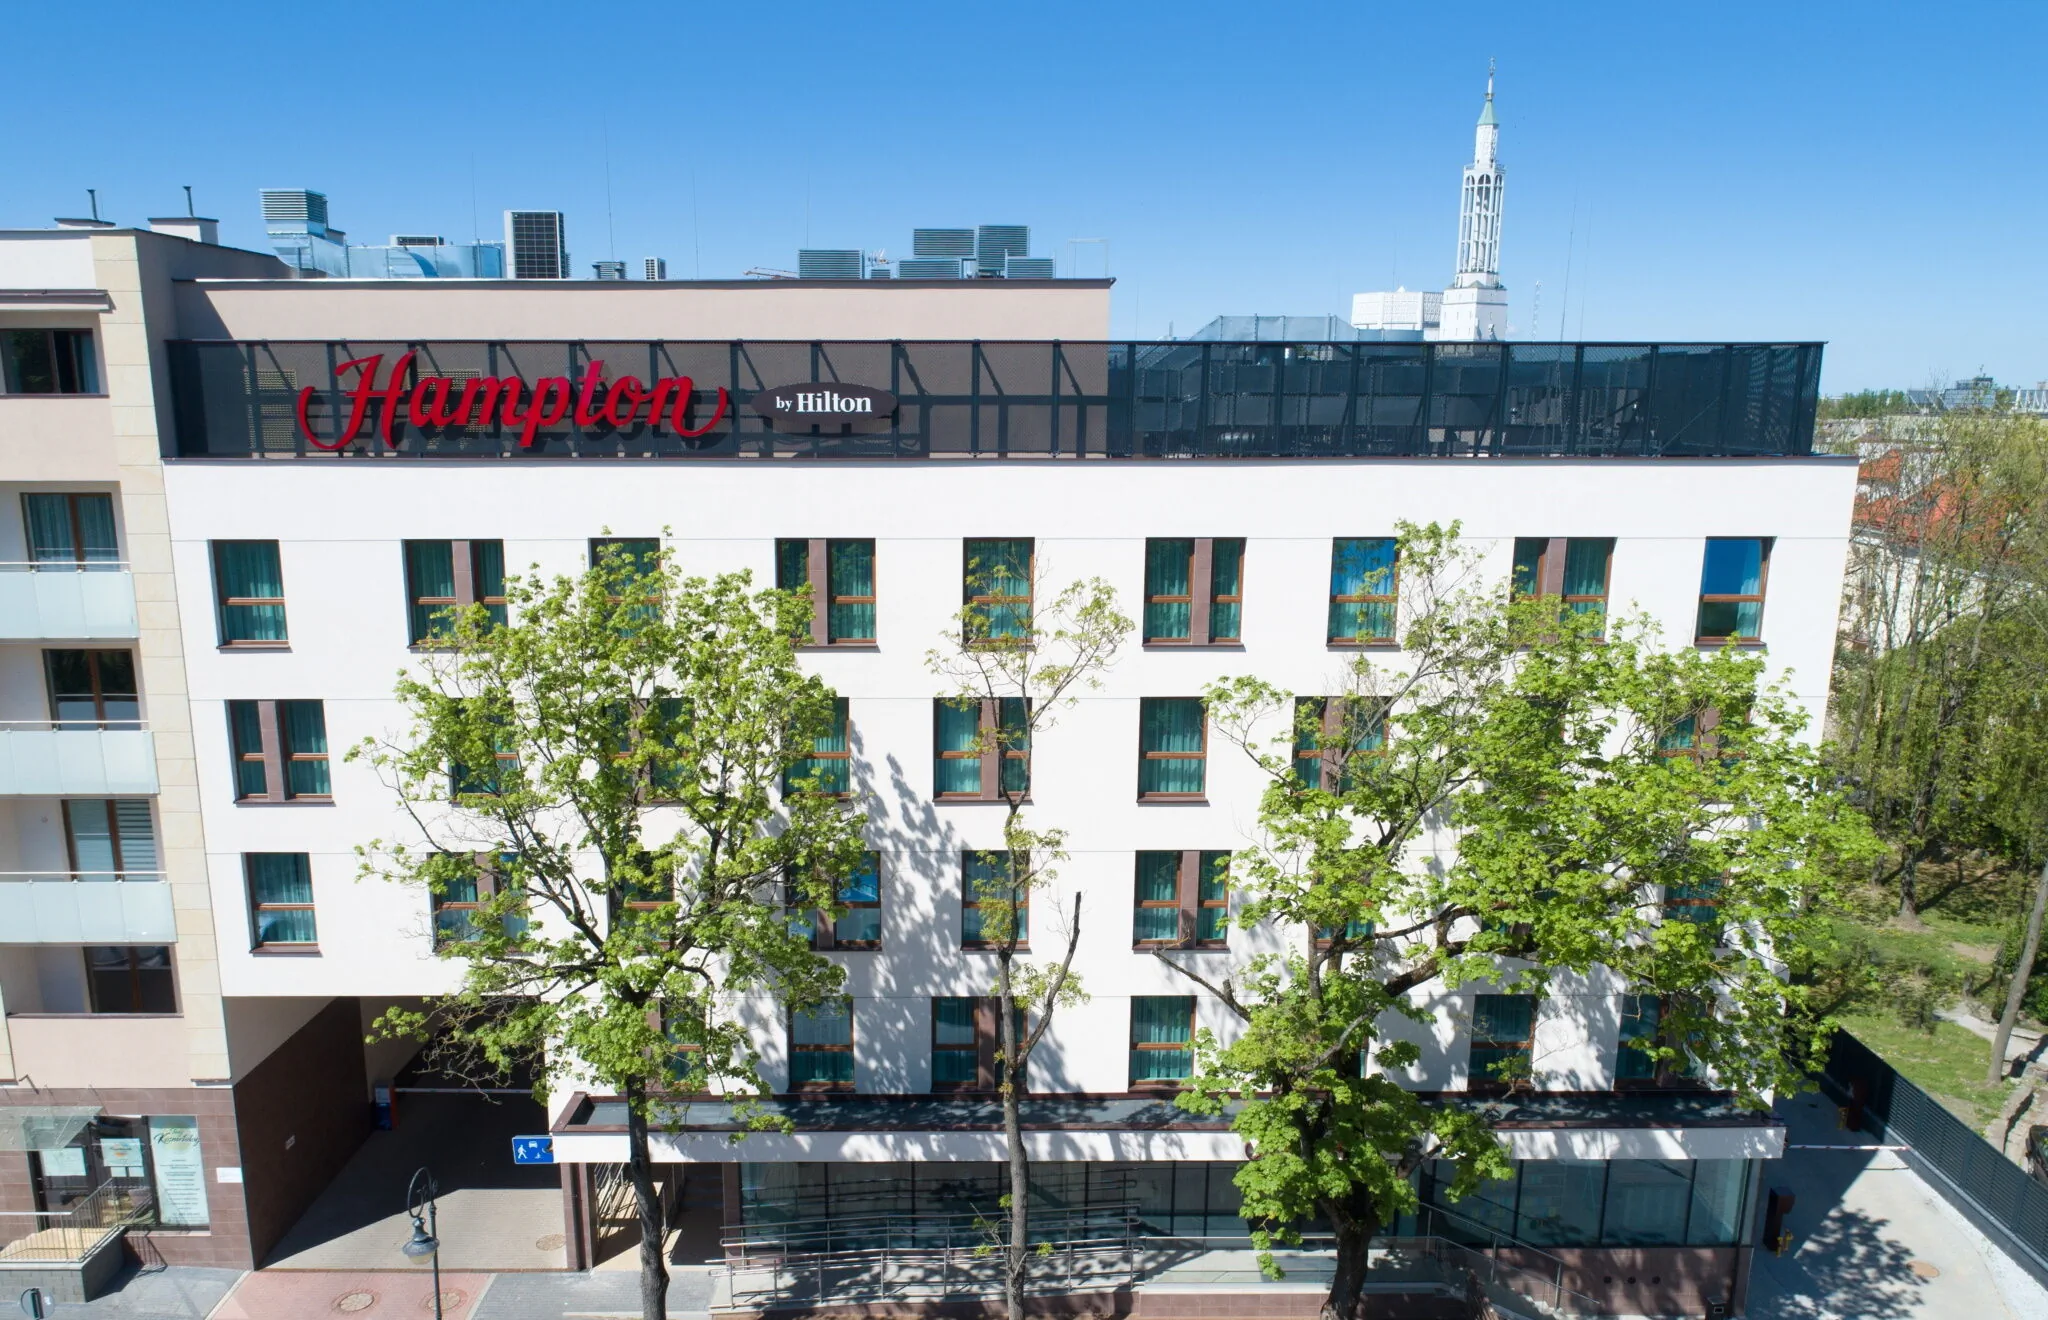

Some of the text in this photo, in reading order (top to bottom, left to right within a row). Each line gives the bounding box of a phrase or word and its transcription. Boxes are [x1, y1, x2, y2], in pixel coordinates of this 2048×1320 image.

[297, 349, 727, 449] Hampton
[775, 390, 873, 413] by Hilton
